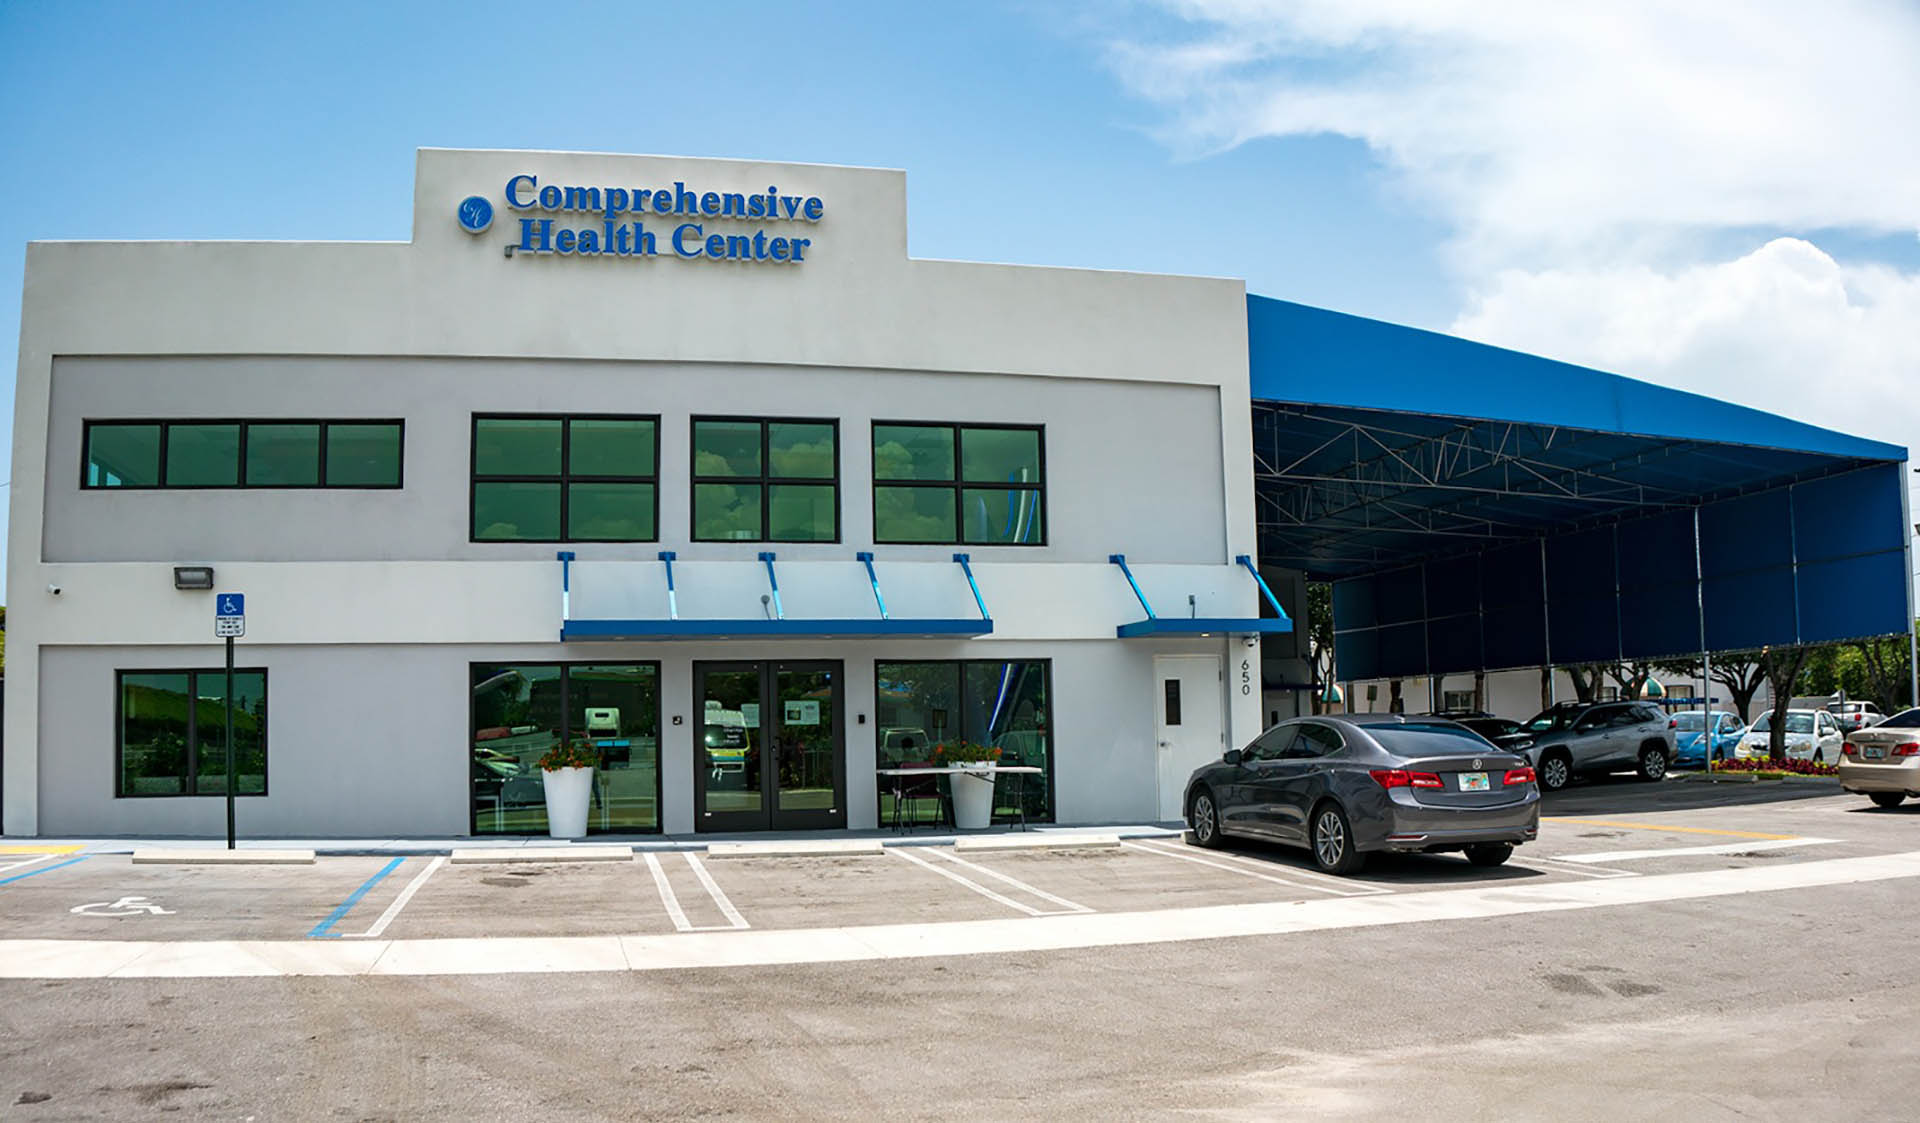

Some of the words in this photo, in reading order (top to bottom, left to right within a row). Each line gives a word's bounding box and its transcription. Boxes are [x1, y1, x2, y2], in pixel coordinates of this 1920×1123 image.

[504, 174, 824, 221] Comprehensive
[517, 218, 658, 256] Health
[671, 222, 813, 263] Center
[1241, 659, 1250, 696] 650
